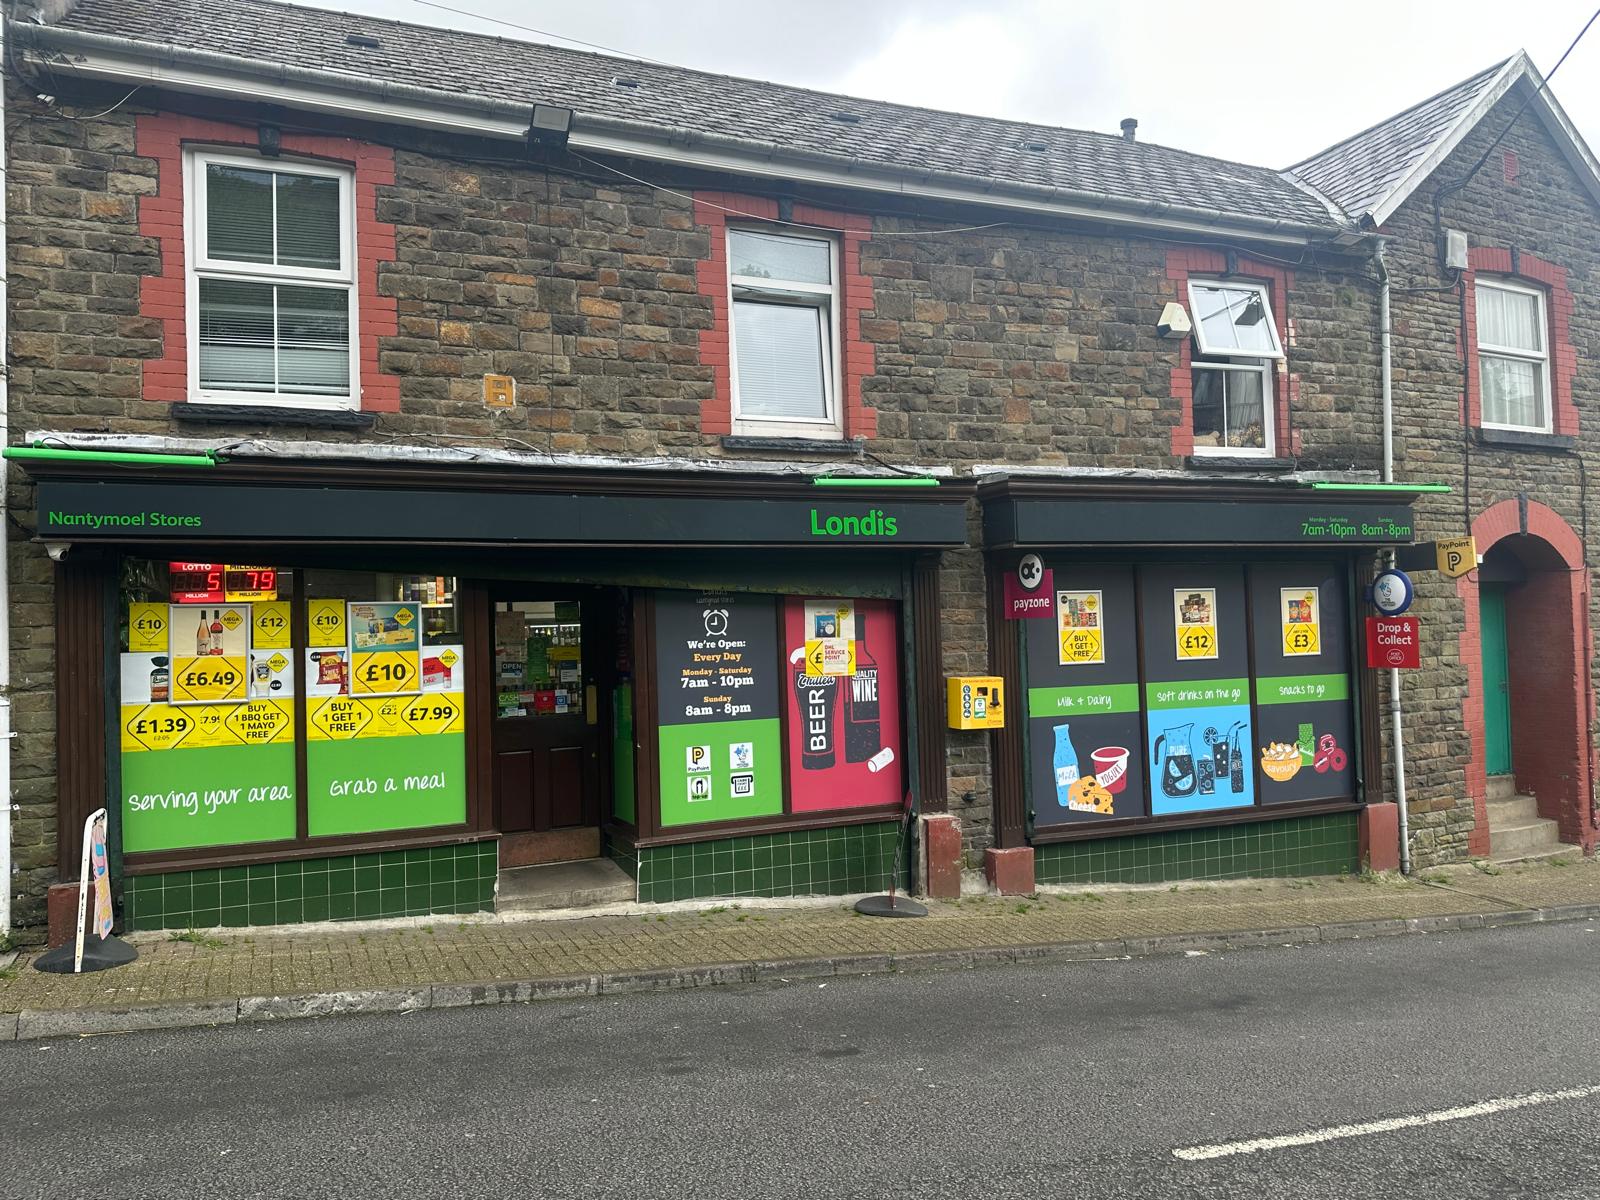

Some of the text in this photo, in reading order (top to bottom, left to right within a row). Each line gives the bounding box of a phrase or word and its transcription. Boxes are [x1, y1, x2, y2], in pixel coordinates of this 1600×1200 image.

[49, 511, 201, 529] Nantymoel Stores
[811, 509, 898, 536] Londis
[1438, 540, 1470, 550] PayPoint
[182, 563, 212, 571] LOTTO
[207, 572, 220, 591] 5
[247, 572, 274, 590] 79
[1014, 597, 1050, 611] payzone
[137, 619, 163, 630] £10
[260, 617, 283, 628] £12
[316, 615, 339, 626] £10
[1377, 622, 1411, 634] Drop &
[687, 640, 746, 650] We're Open:
[1185, 635, 1208, 648] £12
[1294, 634, 1309, 647] £3
[1377, 635, 1412, 645] Collect
[693, 652, 742, 662] Every Day
[185, 672, 235, 687] £6.49
[366, 664, 406, 682] £10
[682, 669, 713, 677] Monday
[680, 677, 709, 688] 7am
[720, 675, 754, 688] 10pm
[852, 679, 878, 703] WINE
[1156, 688, 1241, 702] soft drinks on the go
[1278, 684, 1325, 697] snacks to go
[703, 695, 732, 704] Sunday
[1087, 694, 1112, 709] Dairy
[330, 702, 354, 711] BUY
[685, 705, 713, 716] 8am
[724, 703, 752, 716] 8pm
[242, 714, 261, 722] BBQ
[262, 713, 281, 721] GET
[323, 712, 362, 722] 1 GET 1
[409, 706, 453, 721] £7.99
[808, 688, 828, 751] BEER
[136, 718, 187, 734] £1.39
[247, 722, 275, 730] MAYO
[329, 723, 356, 732] FREE
[246, 731, 269, 739] FREE
[1169, 745, 1188, 756] PURE
[1100, 764, 1123, 785] YOGURT
[329, 771, 445, 796] Grab a meal
[128, 785, 292, 815] serving your area
